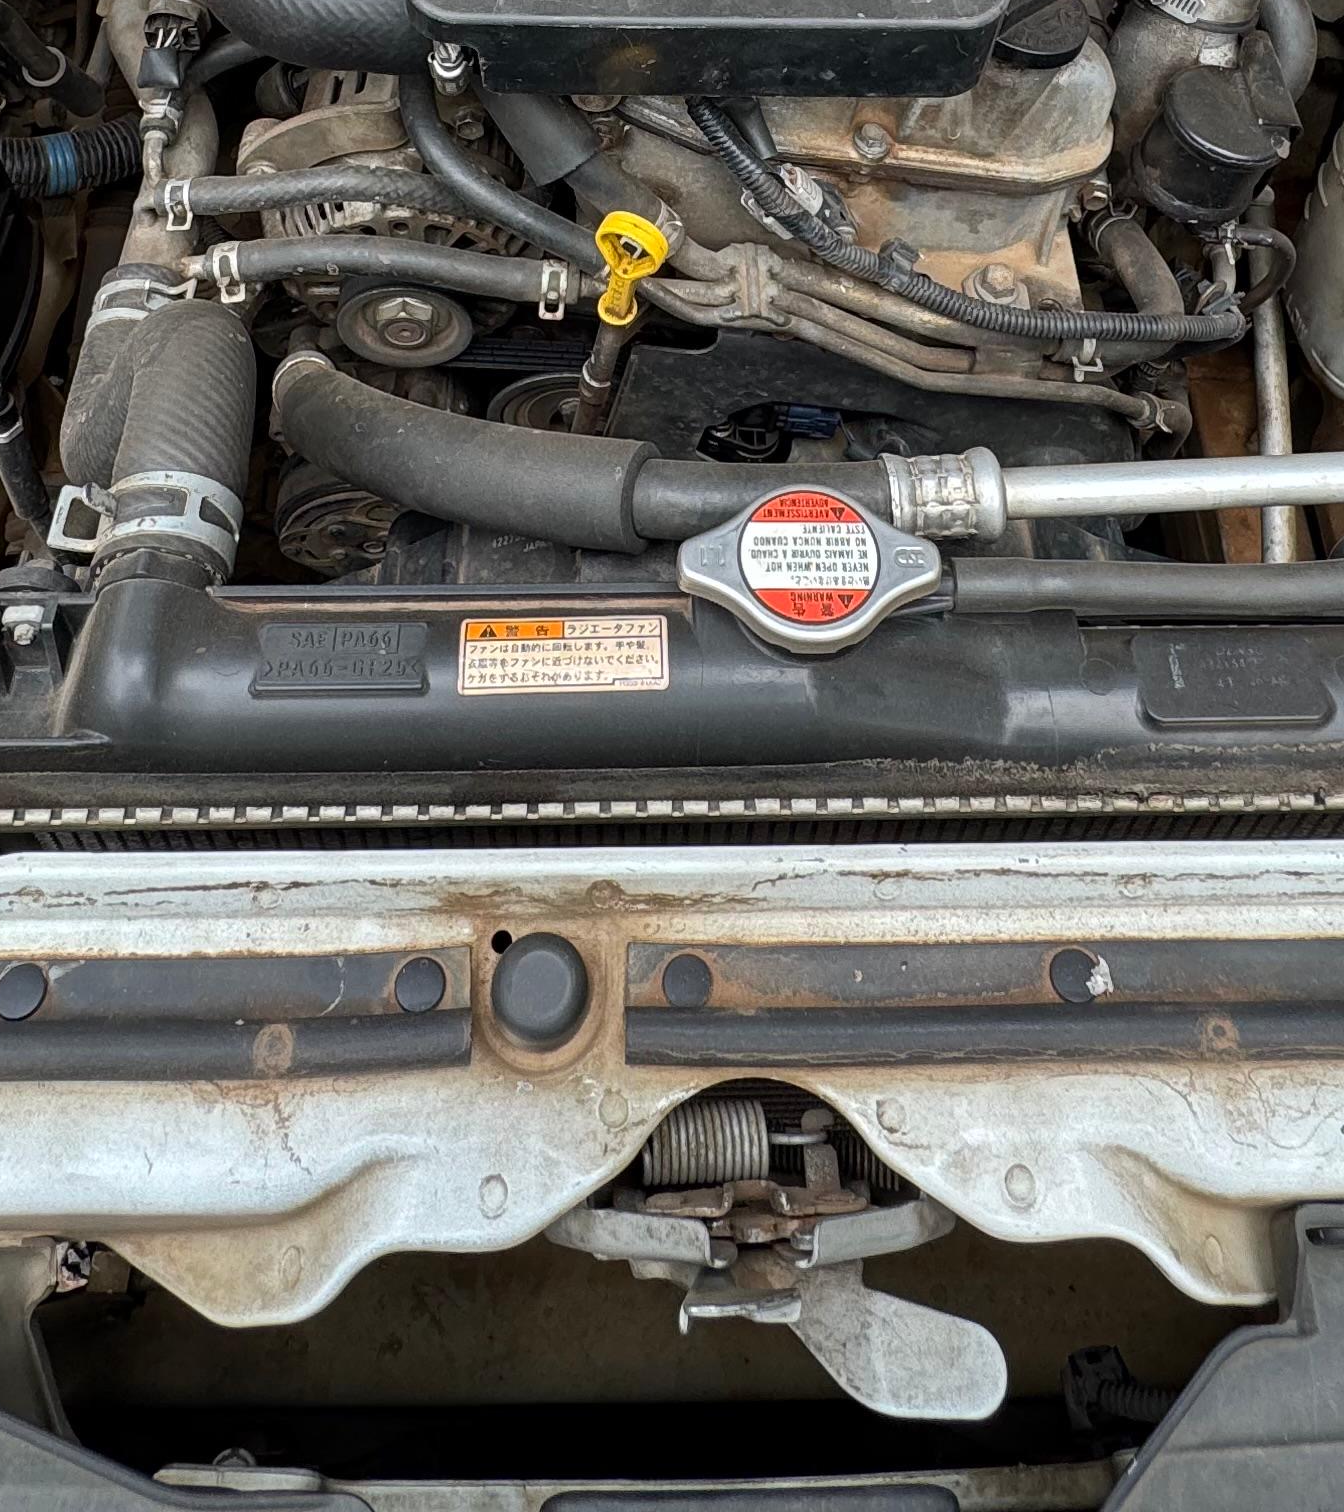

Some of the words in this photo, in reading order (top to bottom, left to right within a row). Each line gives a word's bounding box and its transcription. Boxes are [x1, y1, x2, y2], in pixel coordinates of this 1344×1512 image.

[779, 498, 829, 508] ADVERTENCIA
[763, 509, 829, 518] AVERTISSEMENT
[753, 536, 789, 547] CUANDO
[793, 536, 822, 547] NUNCA
[826, 536, 851, 547] ABRIR
[856, 536, 867, 547] NO
[787, 561, 813, 572] WHEN
[816, 561, 838, 572] OPEN
[842, 561, 869, 572] NEVER
[791, 592, 834, 602] WARNING
[567, 622, 658, 635] ラジエータファン
[290, 630, 329, 649] SAE
[340, 630, 393, 649] PA66
